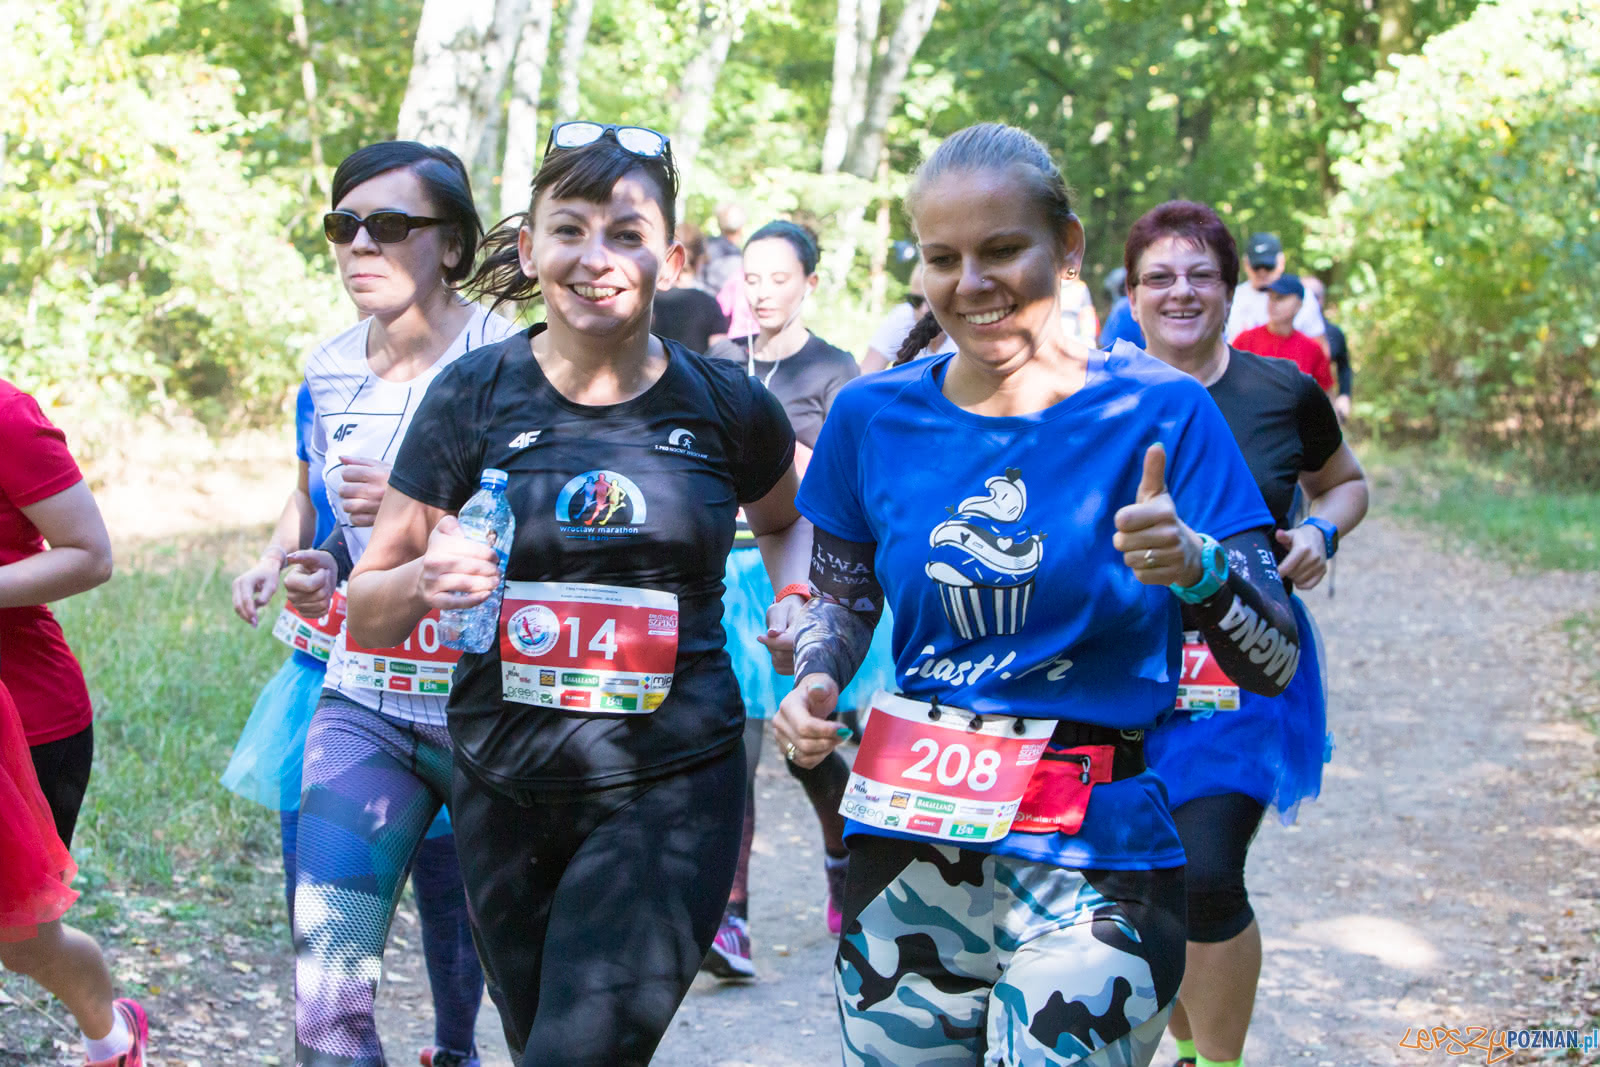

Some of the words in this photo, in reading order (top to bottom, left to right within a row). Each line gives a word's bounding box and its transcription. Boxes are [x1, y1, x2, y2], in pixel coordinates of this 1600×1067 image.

[333, 424, 358, 442] 4F
[508, 430, 542, 448] 4F
[597, 526, 638, 534] marathon
[562, 616, 618, 660] 14
[1218, 593, 1299, 687] MAGNA
[653, 675, 674, 686] mjp
[506, 686, 539, 699] green
[901, 738, 1002, 792] 208
